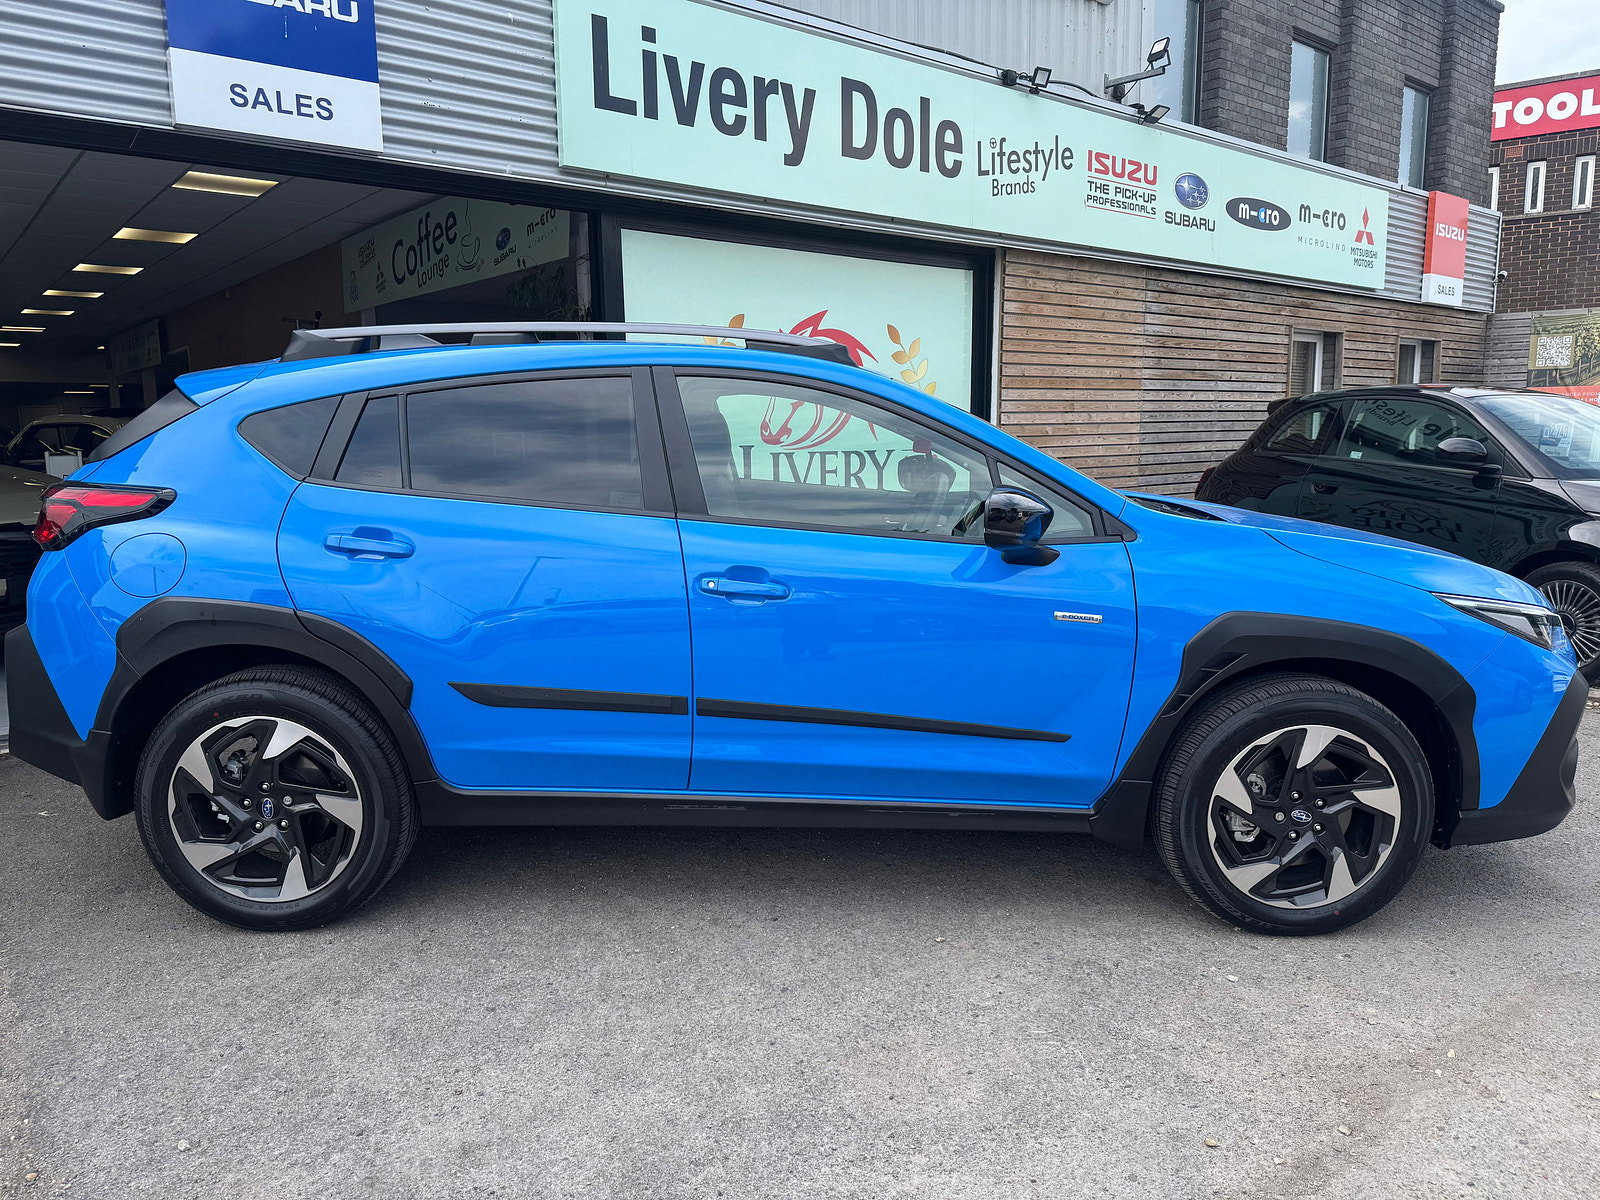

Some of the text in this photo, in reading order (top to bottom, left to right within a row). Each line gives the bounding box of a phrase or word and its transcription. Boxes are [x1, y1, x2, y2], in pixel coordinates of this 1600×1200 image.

[229, 83, 334, 121] SALES
[591, 13, 963, 179] Livery Dole
[977, 134, 1074, 182] Lifestyle
[1087, 149, 1158, 186] ISUZU
[992, 175, 1036, 197] Brands
[1087, 180, 1157, 204] THE PICK-UP
[1086, 194, 1157, 216] PROFESSIONALS
[1164, 210, 1216, 232] SUBARU
[1435, 222, 1465, 242] ISUZU
[392, 211, 458, 285] Coffee
[1297, 235, 1346, 252] MICROLINO
[1350, 246, 1378, 259] MITSUBISHI
[493, 245, 517, 267] SUBARU
[1353, 257, 1374, 269] MOTORS
[417, 254, 450, 289] Lounge
[1437, 284, 1456, 297] SALES
